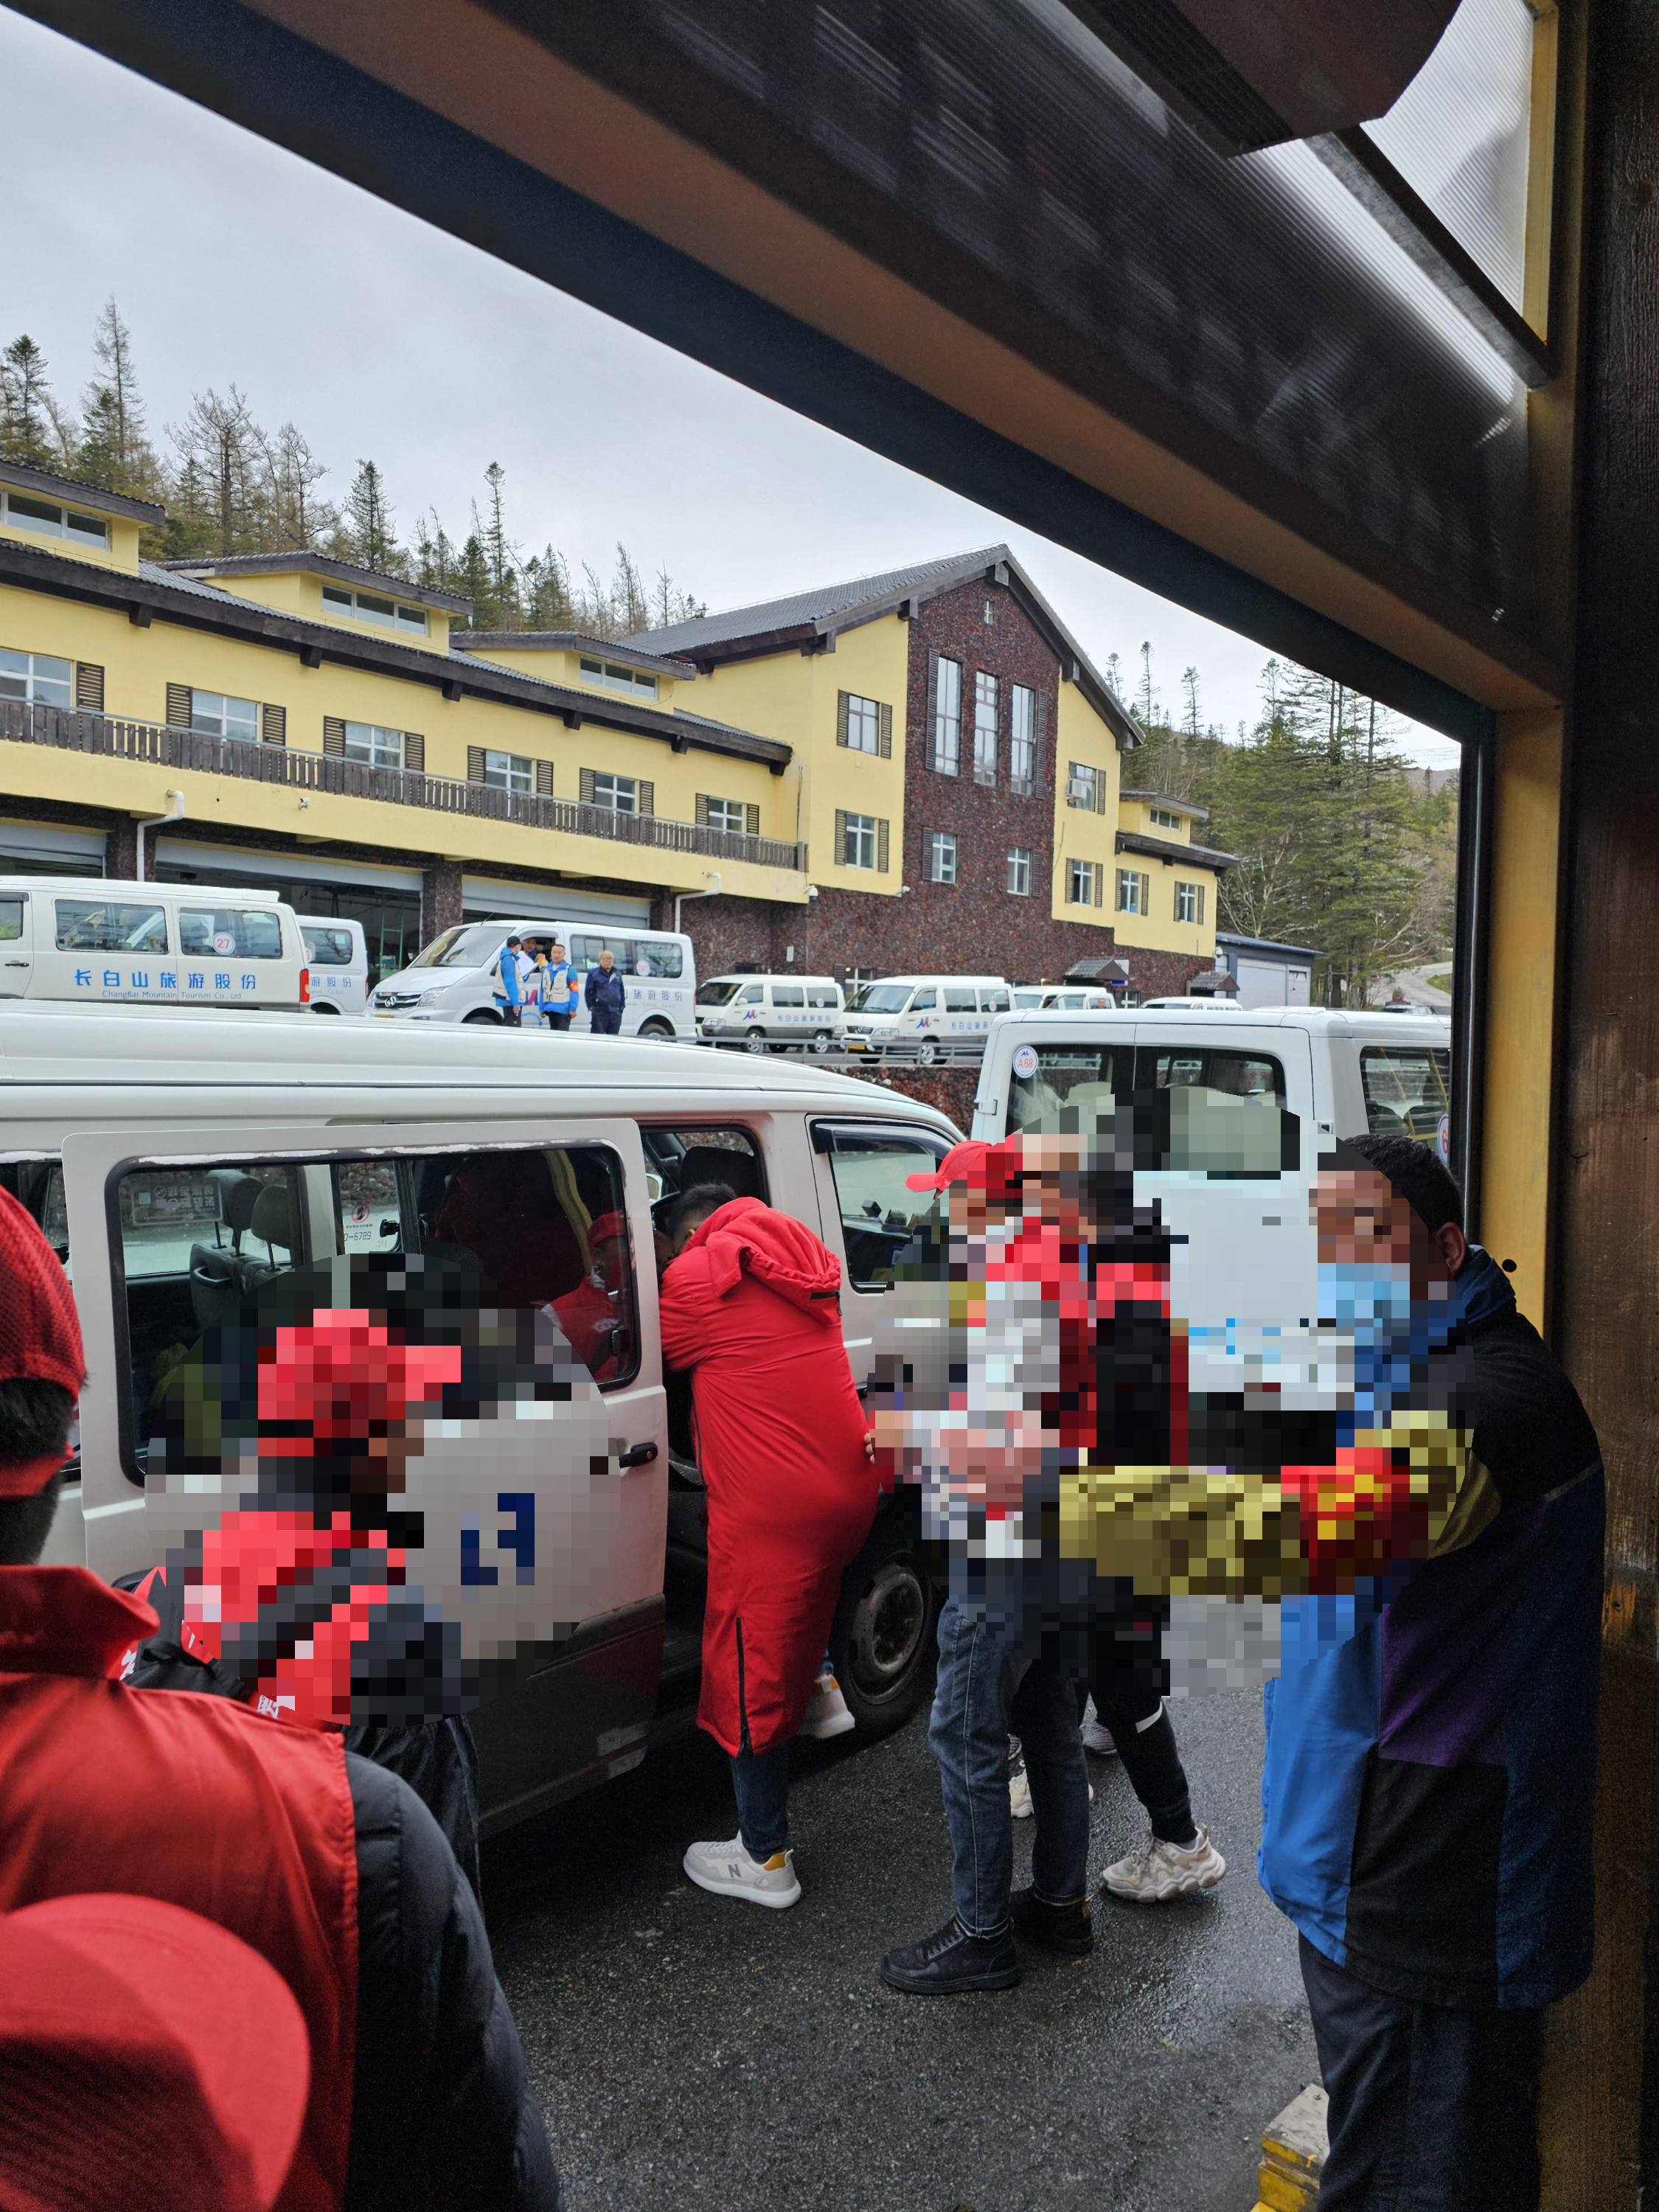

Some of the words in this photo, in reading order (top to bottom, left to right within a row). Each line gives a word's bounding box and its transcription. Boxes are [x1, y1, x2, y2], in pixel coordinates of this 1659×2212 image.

[217, 938, 229, 949] 27
[74, 969, 256, 990] 长白山旅游股份
[102, 990, 139, 1000] ChangBai
[728, 1864, 741, 1878] N
